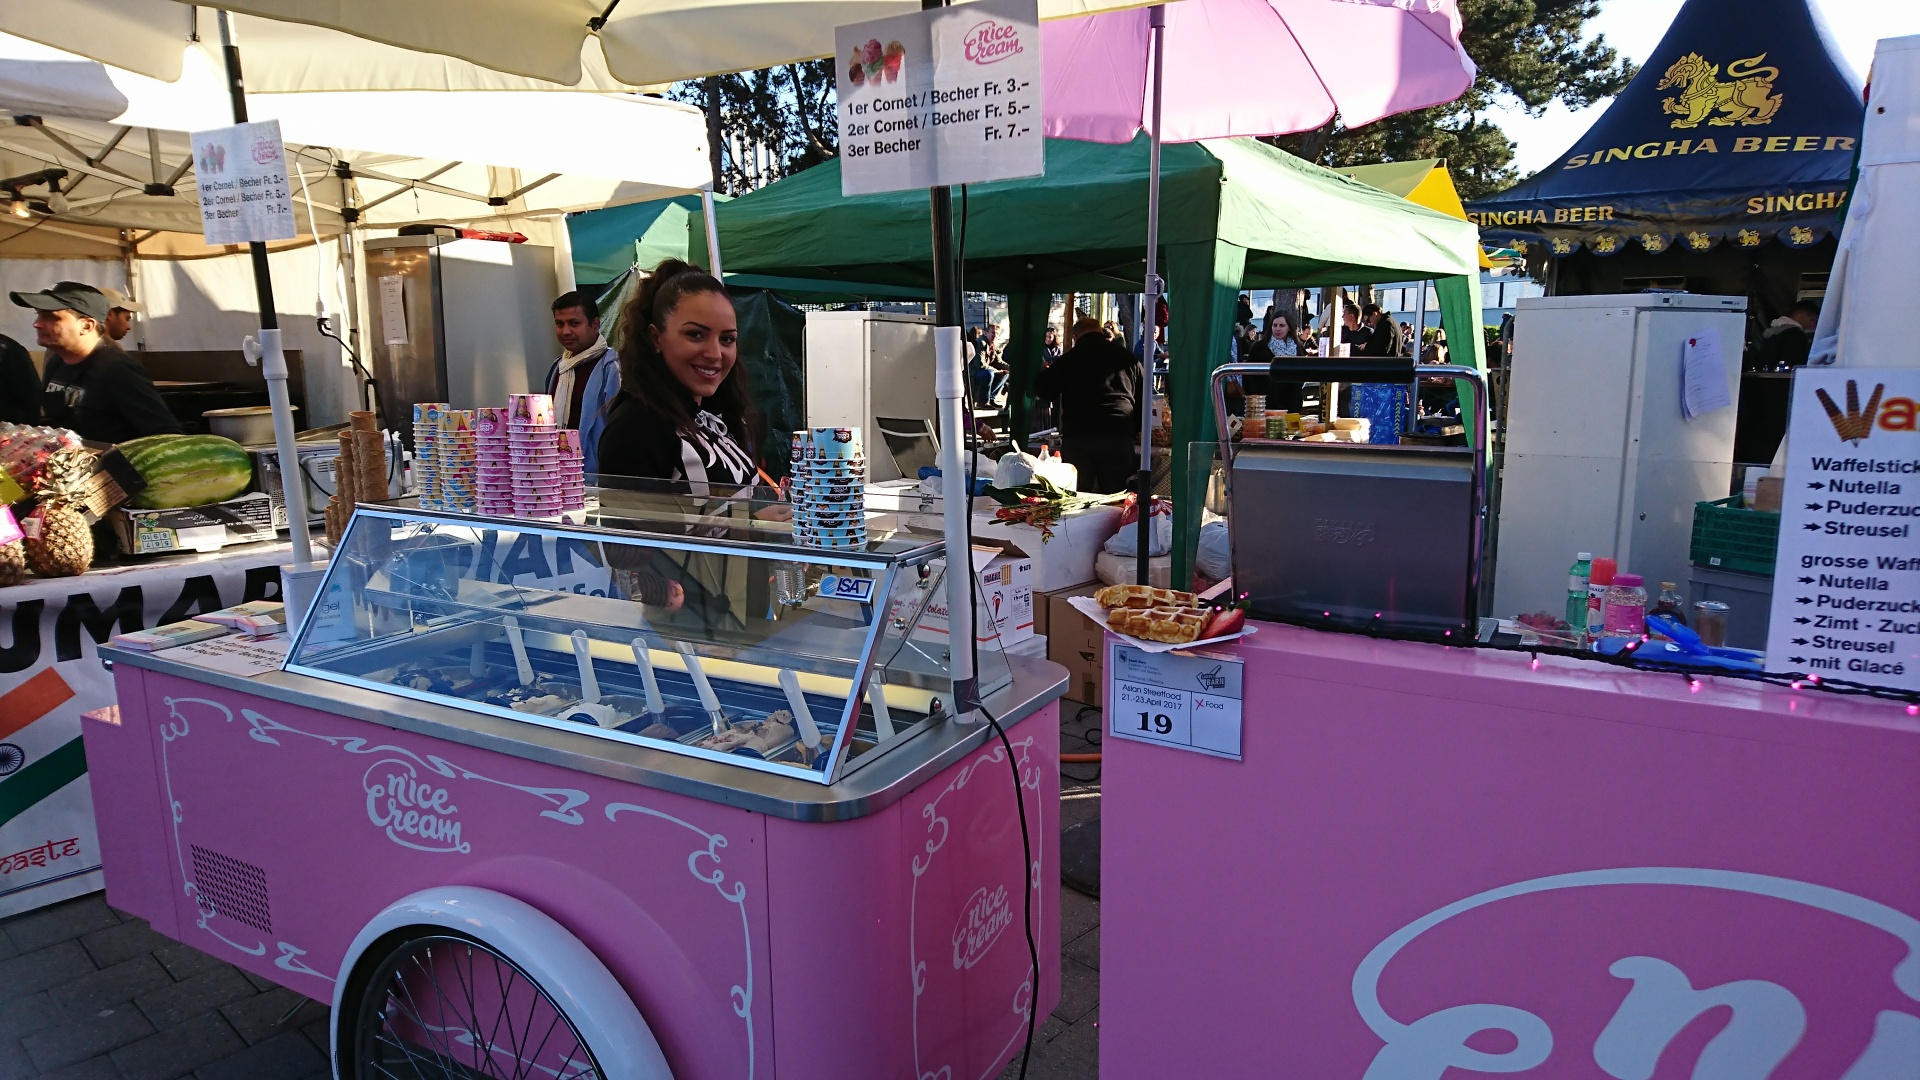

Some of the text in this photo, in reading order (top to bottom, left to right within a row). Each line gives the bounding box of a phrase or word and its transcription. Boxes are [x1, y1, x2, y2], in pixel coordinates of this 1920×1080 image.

[964, 37, 1024, 65] Cream
[847, 101, 869, 116] 1er
[873, 94, 918, 112] Cornet
[920, 92, 927, 107] /
[931, 86, 979, 105] Becher
[984, 81, 1002, 97] Fr.
[847, 122, 870, 137] 2er
[874, 116, 919, 134] Cornet
[922, 113, 928, 129] /
[931, 107, 980, 126] Becher
[985, 104, 1003, 119] Fr.
[847, 144, 870, 157] 3er
[874, 138, 921, 155] Becher
[984, 126, 1002, 141] Fr.
[1562, 135, 1857, 170] SINGHA BEER
[213, 181, 235, 190] Cornet
[239, 178, 262, 188] Becher
[202, 197, 214, 206] 2er
[215, 195, 237, 205] Cornet
[241, 192, 264, 202] Becher
[204, 211, 216, 220] 3er
[216, 209, 239, 219] Becher
[1467, 205, 1614, 227] SINGHA BEER
[1828, 478, 1901, 495] Nutella
[1824, 520, 1909, 538] Streusel
[1801, 554, 1869, 569] grosse
[836, 577, 860, 594] ISA
[1818, 573, 1889, 591] Nutella
[1813, 614, 1860, 632] Zimt
[1811, 634, 1895, 654] Streusel
[1809, 655, 1905, 676] mit Glacé
[1122, 683, 1182, 701] Asian Streetfood
[1163, 701, 1183, 711] 2017
[1205, 701, 1224, 710] Food
[1136, 711, 1173, 735] 19
[364, 782, 471, 853] Cream
[952, 901, 1013, 970] Cream
